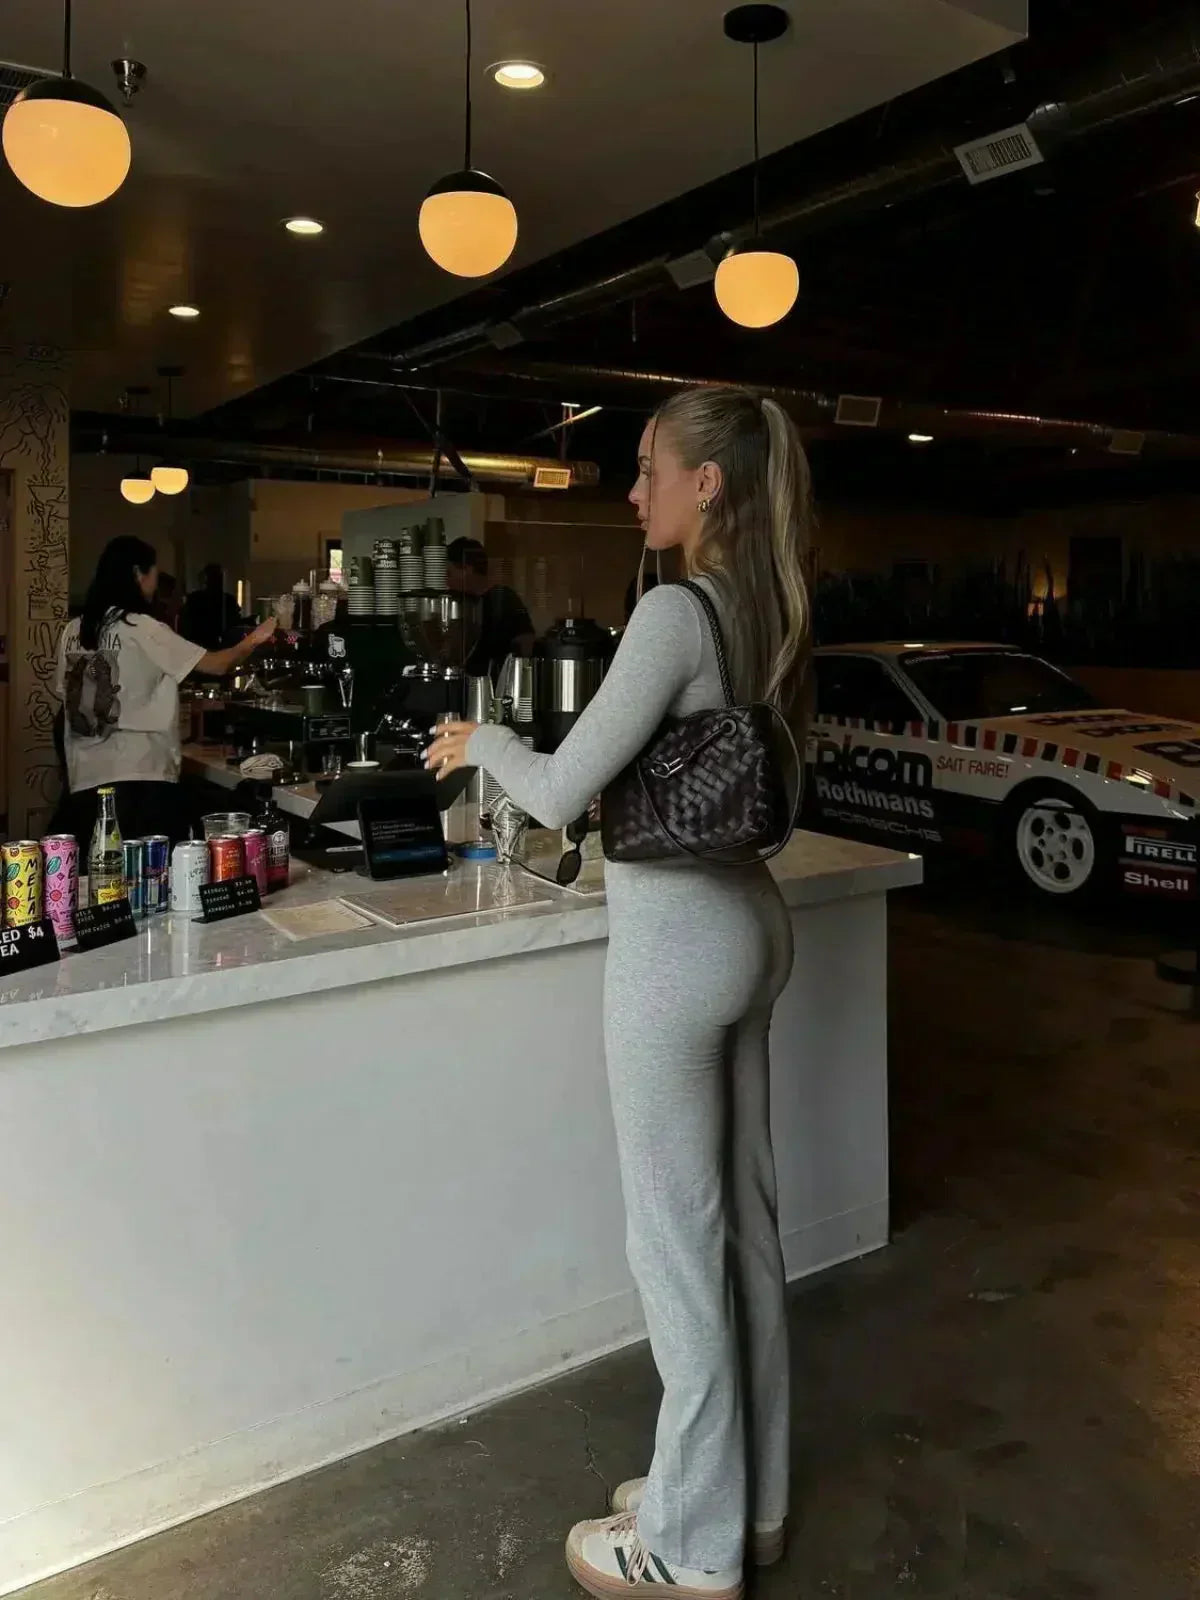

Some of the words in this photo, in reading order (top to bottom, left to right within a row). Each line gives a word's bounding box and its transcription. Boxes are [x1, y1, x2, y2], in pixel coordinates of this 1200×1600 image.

[936, 756, 965, 773] SAIT
[968, 759, 1009, 778] FAIRE!
[815, 774, 936, 819] Rothmans
[25, 858, 38, 916] MELA
[66, 850, 78, 908] MELA
[1123, 871, 1189, 892] Shell
[0, 929, 21, 944] ED
[28, 926, 45, 940] $4
